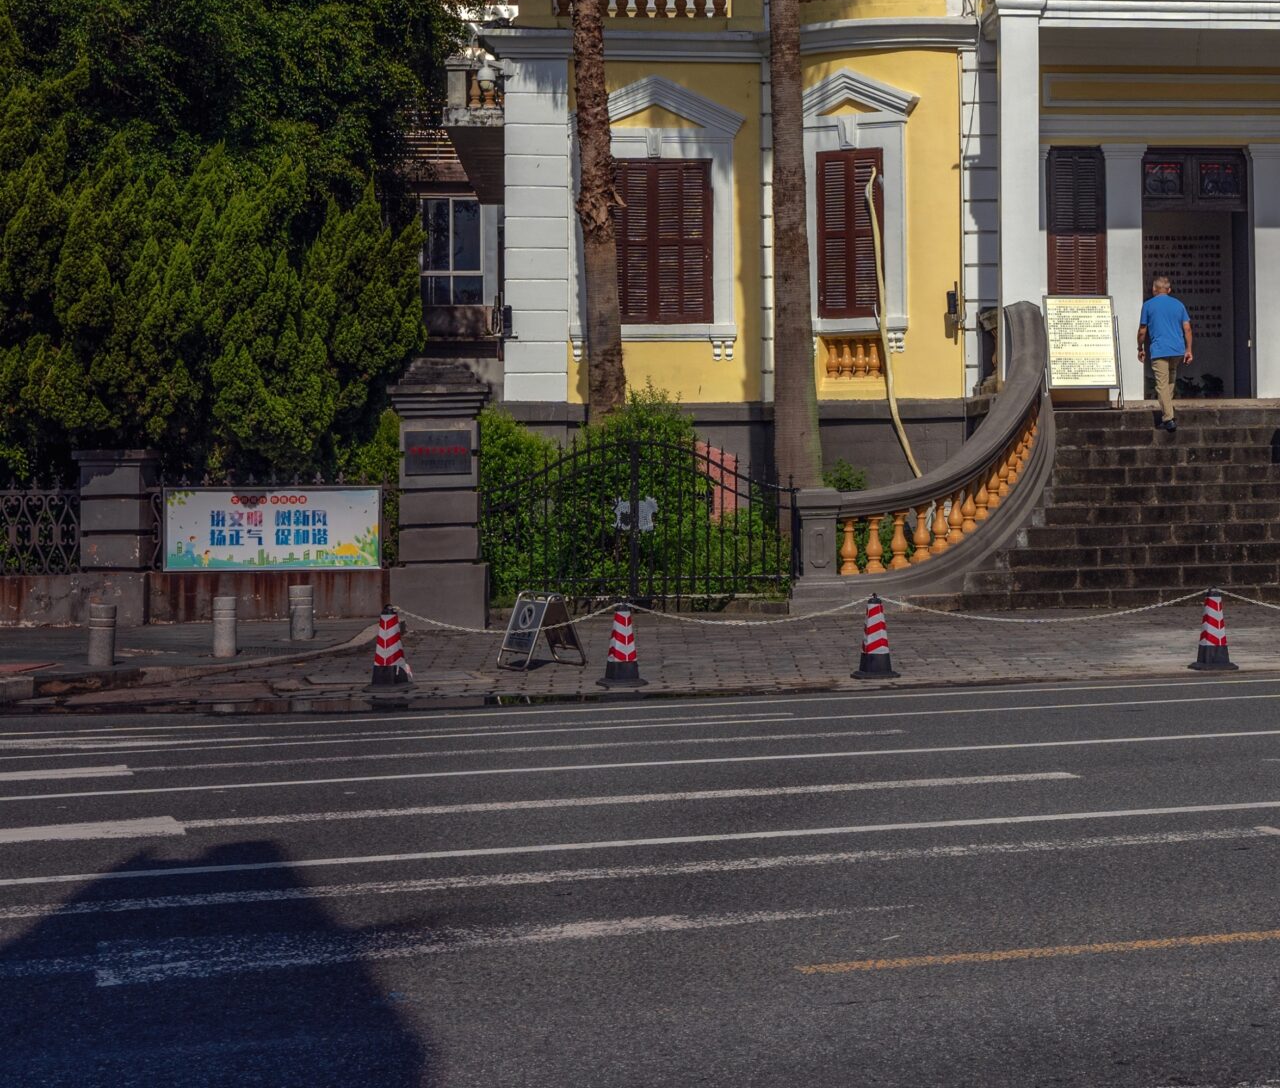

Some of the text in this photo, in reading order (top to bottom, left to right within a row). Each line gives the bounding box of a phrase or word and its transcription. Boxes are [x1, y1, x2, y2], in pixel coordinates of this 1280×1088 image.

[210, 510, 327, 527] 讲文明 树新风
[210, 529, 328, 546] 扬正气 促和谐
